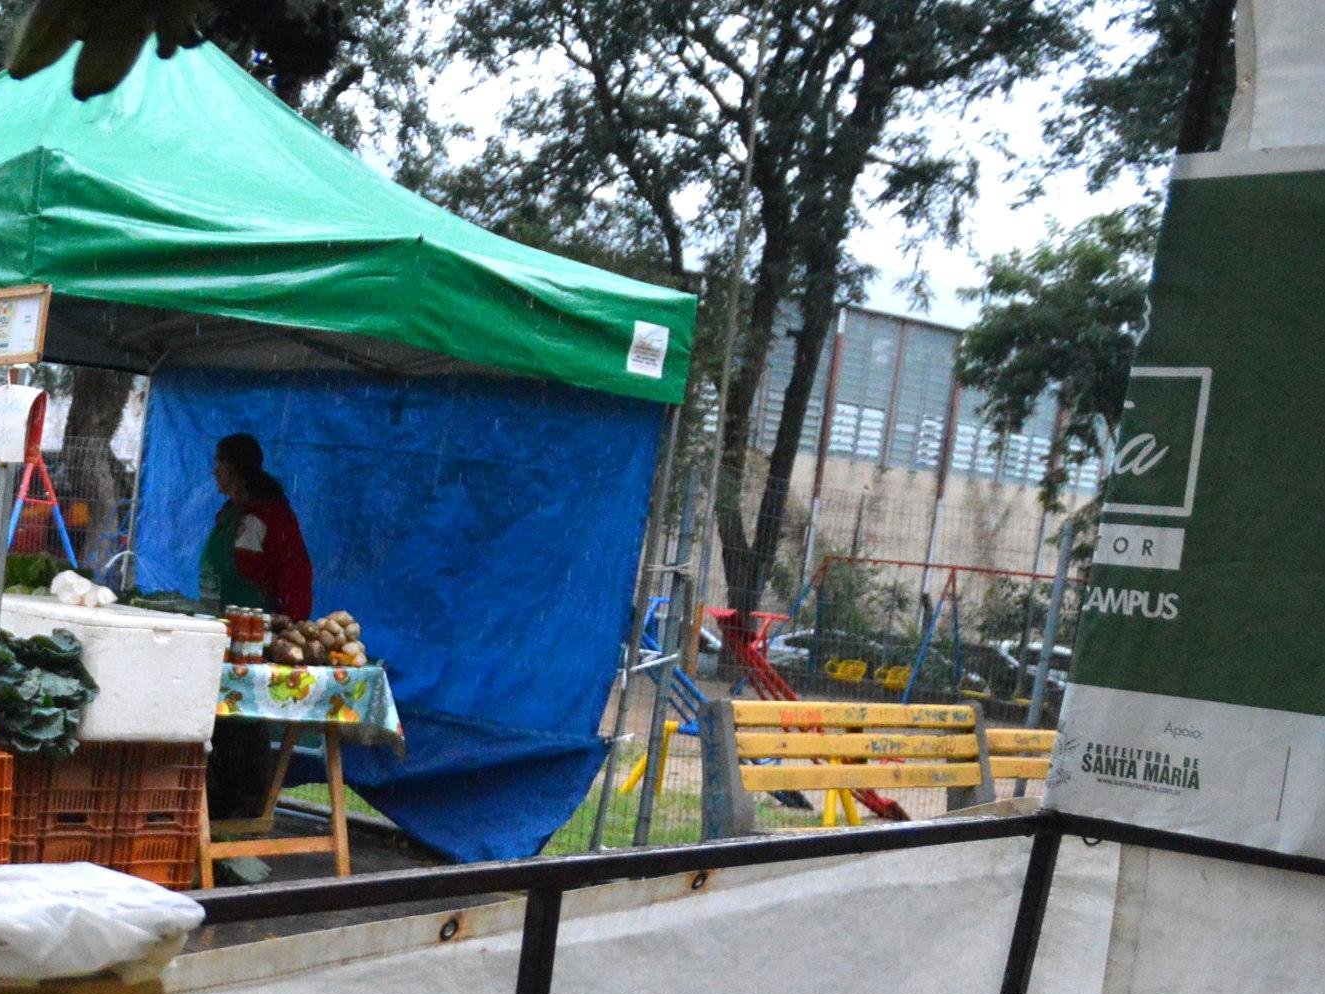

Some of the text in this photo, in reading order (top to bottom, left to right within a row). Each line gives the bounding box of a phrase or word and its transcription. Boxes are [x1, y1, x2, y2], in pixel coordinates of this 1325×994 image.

[1097, 535, 1155, 556] OR
[1081, 585, 1180, 620] AMPUS
[1081, 753, 1201, 790] SANTA MARIA
[1086, 742, 1199, 770] PREFEITURA DE
